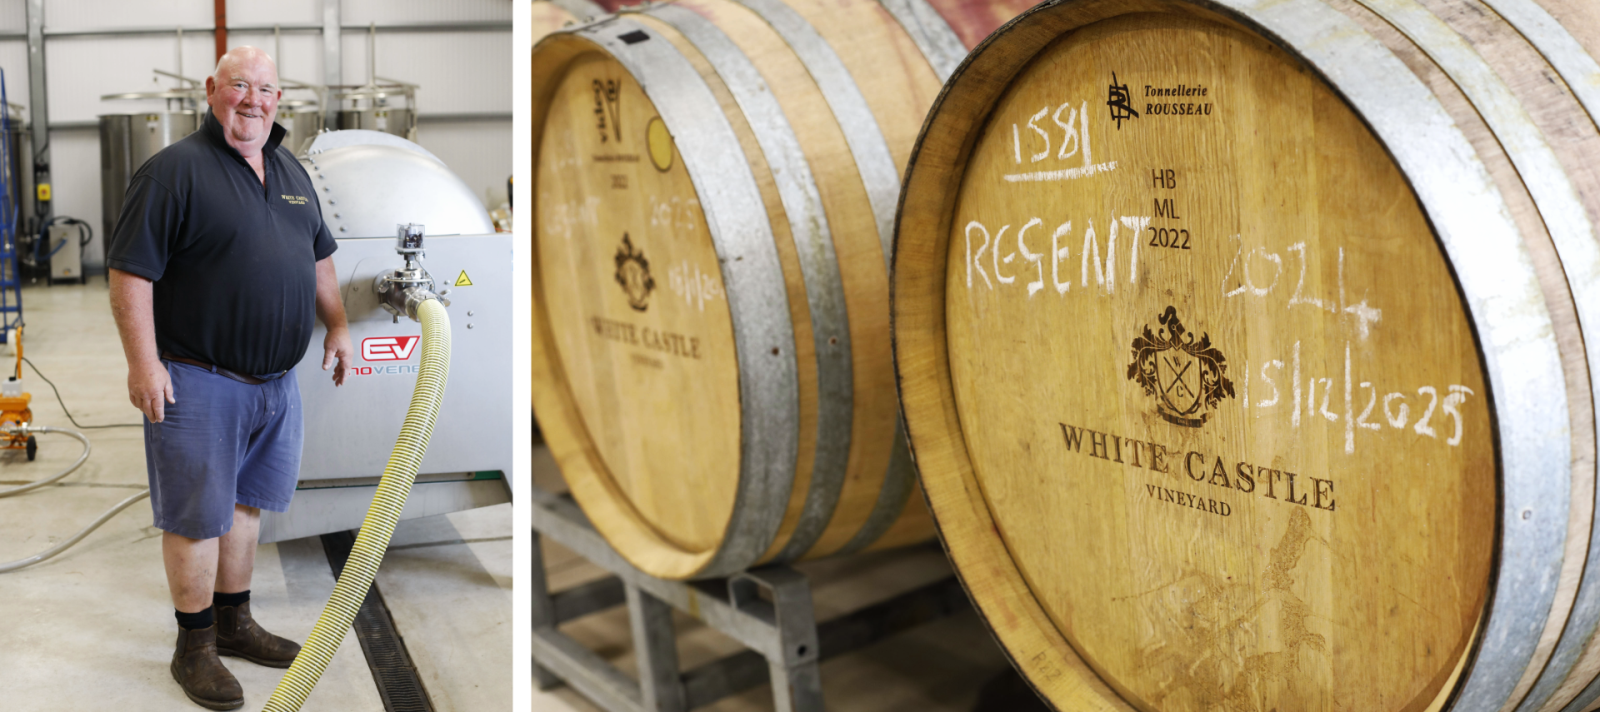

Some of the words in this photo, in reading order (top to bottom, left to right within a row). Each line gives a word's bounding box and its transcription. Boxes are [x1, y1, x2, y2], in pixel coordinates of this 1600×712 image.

[1144, 84, 1208, 97] Tonnellerie
[1145, 103, 1213, 116] ROUSSEAU
[1012, 99, 1093, 166] 1581
[1151, 168, 1177, 190] HB
[1153, 198, 1180, 220] ML
[1147, 226, 1192, 250] 2022
[361, 335, 420, 361] EV
[641, 326, 702, 360] CASTLE
[1058, 422, 1170, 474] WHITE
[1183, 450, 1336, 511] CASTLE
[1145, 484, 1232, 517] VINEYARD
